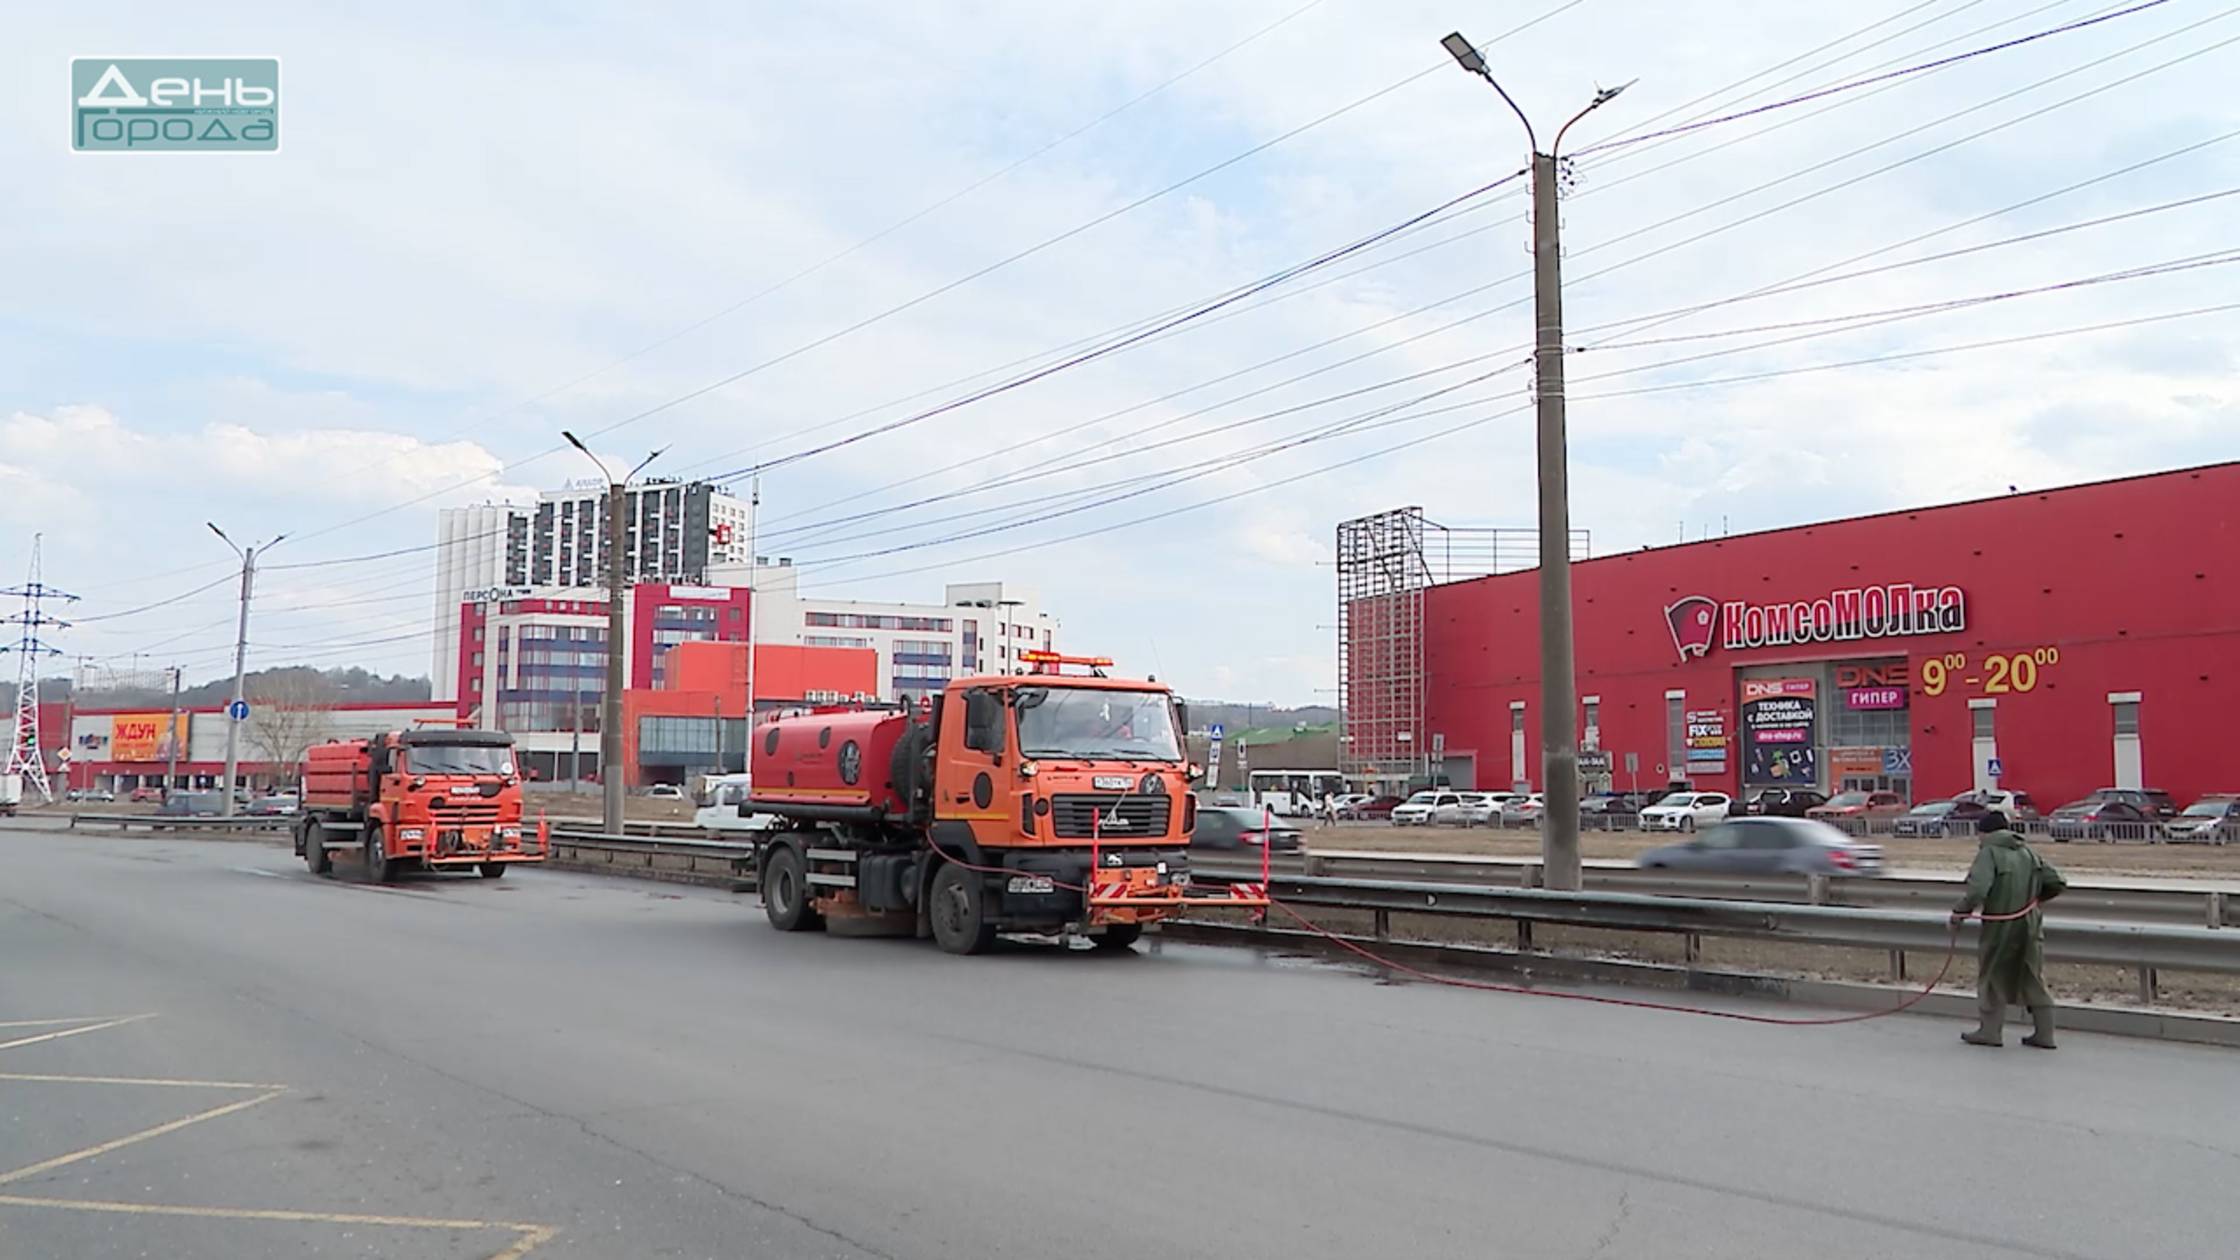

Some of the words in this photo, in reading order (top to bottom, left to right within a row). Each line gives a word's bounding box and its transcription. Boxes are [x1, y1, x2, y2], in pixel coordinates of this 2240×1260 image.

[463, 587, 514, 602] ПЕРСОНА
[1745, 682, 1783, 696] DNS
[1851, 691, 1899, 705] ГИПЕР
[1757, 700, 1802, 711] ТЕХНИКА
[1755, 708, 1814, 723] ДОСТАВКОЙ
[115, 723, 157, 740] ЖДУН
